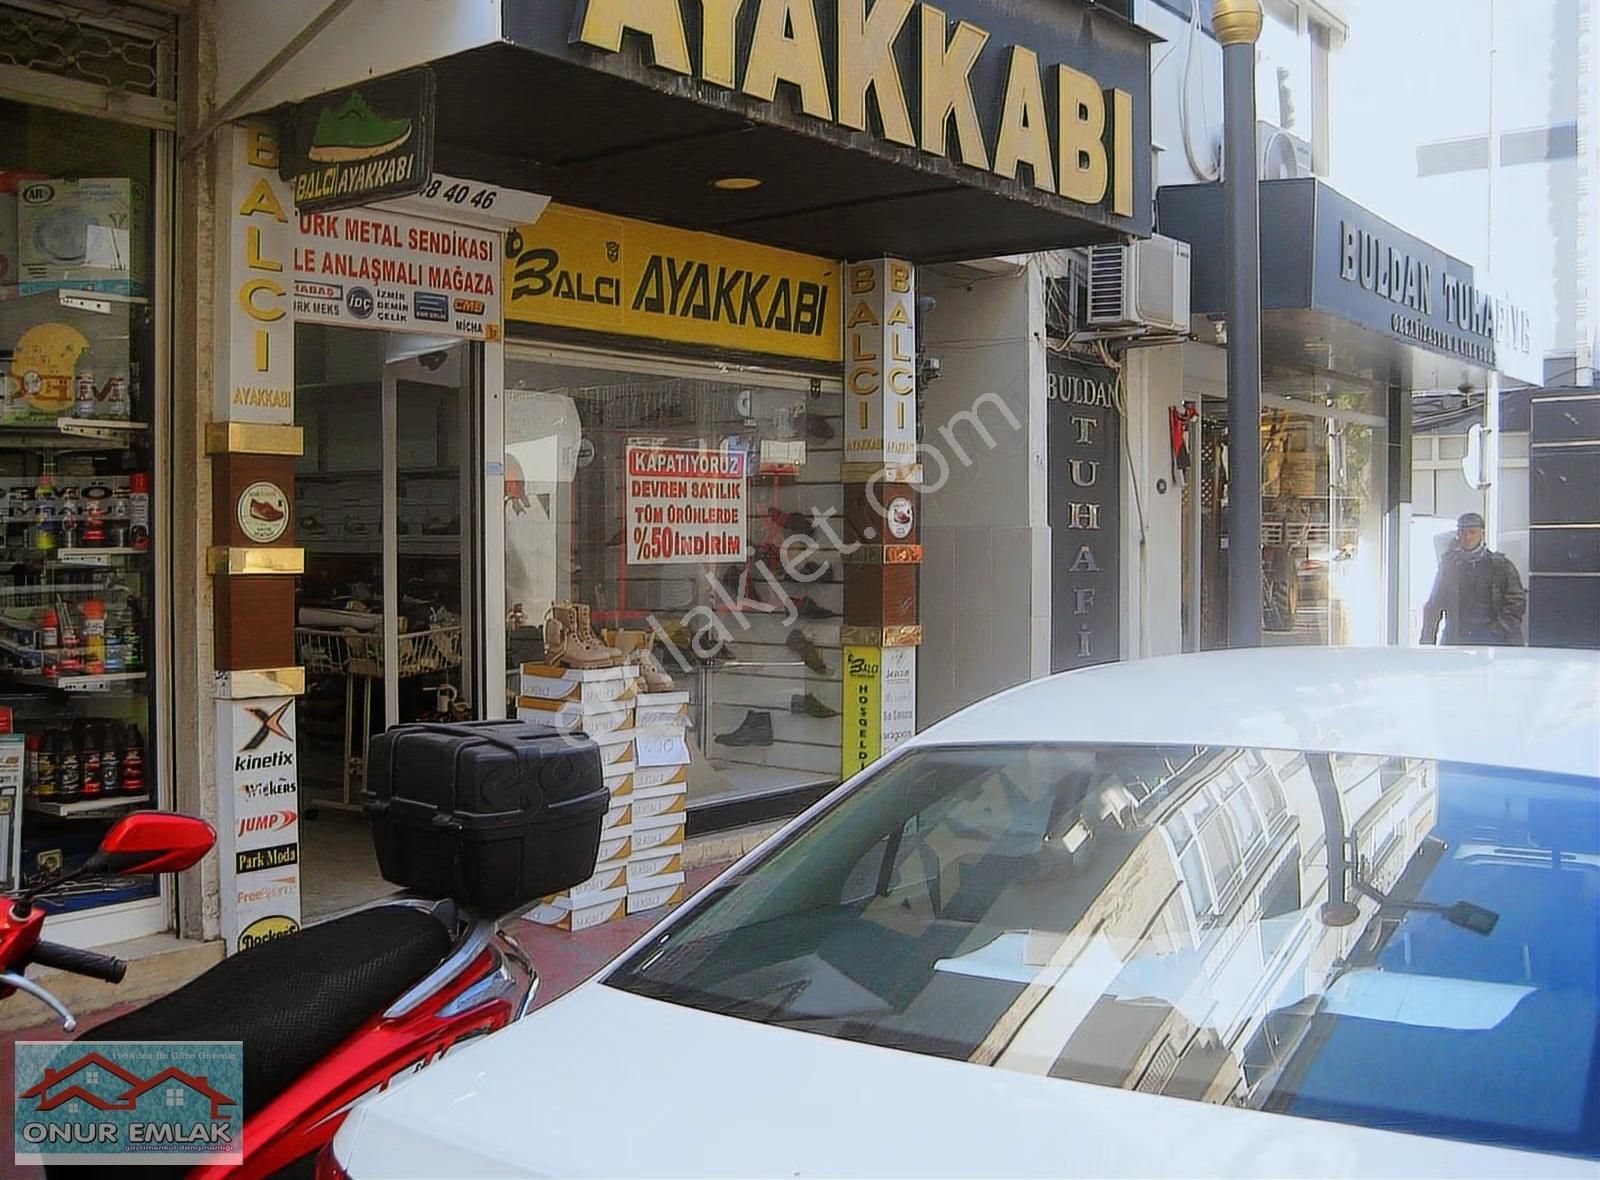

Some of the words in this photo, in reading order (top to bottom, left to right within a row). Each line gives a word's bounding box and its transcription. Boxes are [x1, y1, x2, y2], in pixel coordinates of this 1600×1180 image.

[297, 166, 337, 199] BALCI
[338, 153, 414, 194] AYAKKABI
[421, 180, 441, 198] 8
[443, 184, 469, 203] 40
[471, 190, 496, 209] 46
[345, 218, 403, 248] METAL
[408, 228, 493, 262] SENDİKASI
[322, 252, 423, 286] ANLAŞMALI
[428, 265, 494, 296] MAĞAZA
[511, 247, 620, 306] BALCI
[1340, 220, 1433, 315] BULDAN
[847, 265, 881, 430] BALCI
[887, 262, 914, 430] BALCI
[233, 387, 291, 408] AYAKKABI
[1047, 373, 1116, 408] BULDAN
[635, 452, 739, 474] KAPATIYORUZ
[631, 481, 688, 498] DEVREN
[691, 482, 741, 499] SATILIK
[635, 504, 663, 524] TÜM
[667, 504, 739, 524] ÜRÜNLERDE
[633, 526, 673, 560] %50
[674, 531, 741, 556] İNDİRİM
[235, 751, 293, 771] kinetix
[238, 813, 279, 837] JUMP
[239, 851, 265, 871] Park
[266, 846, 296, 867] Moda
